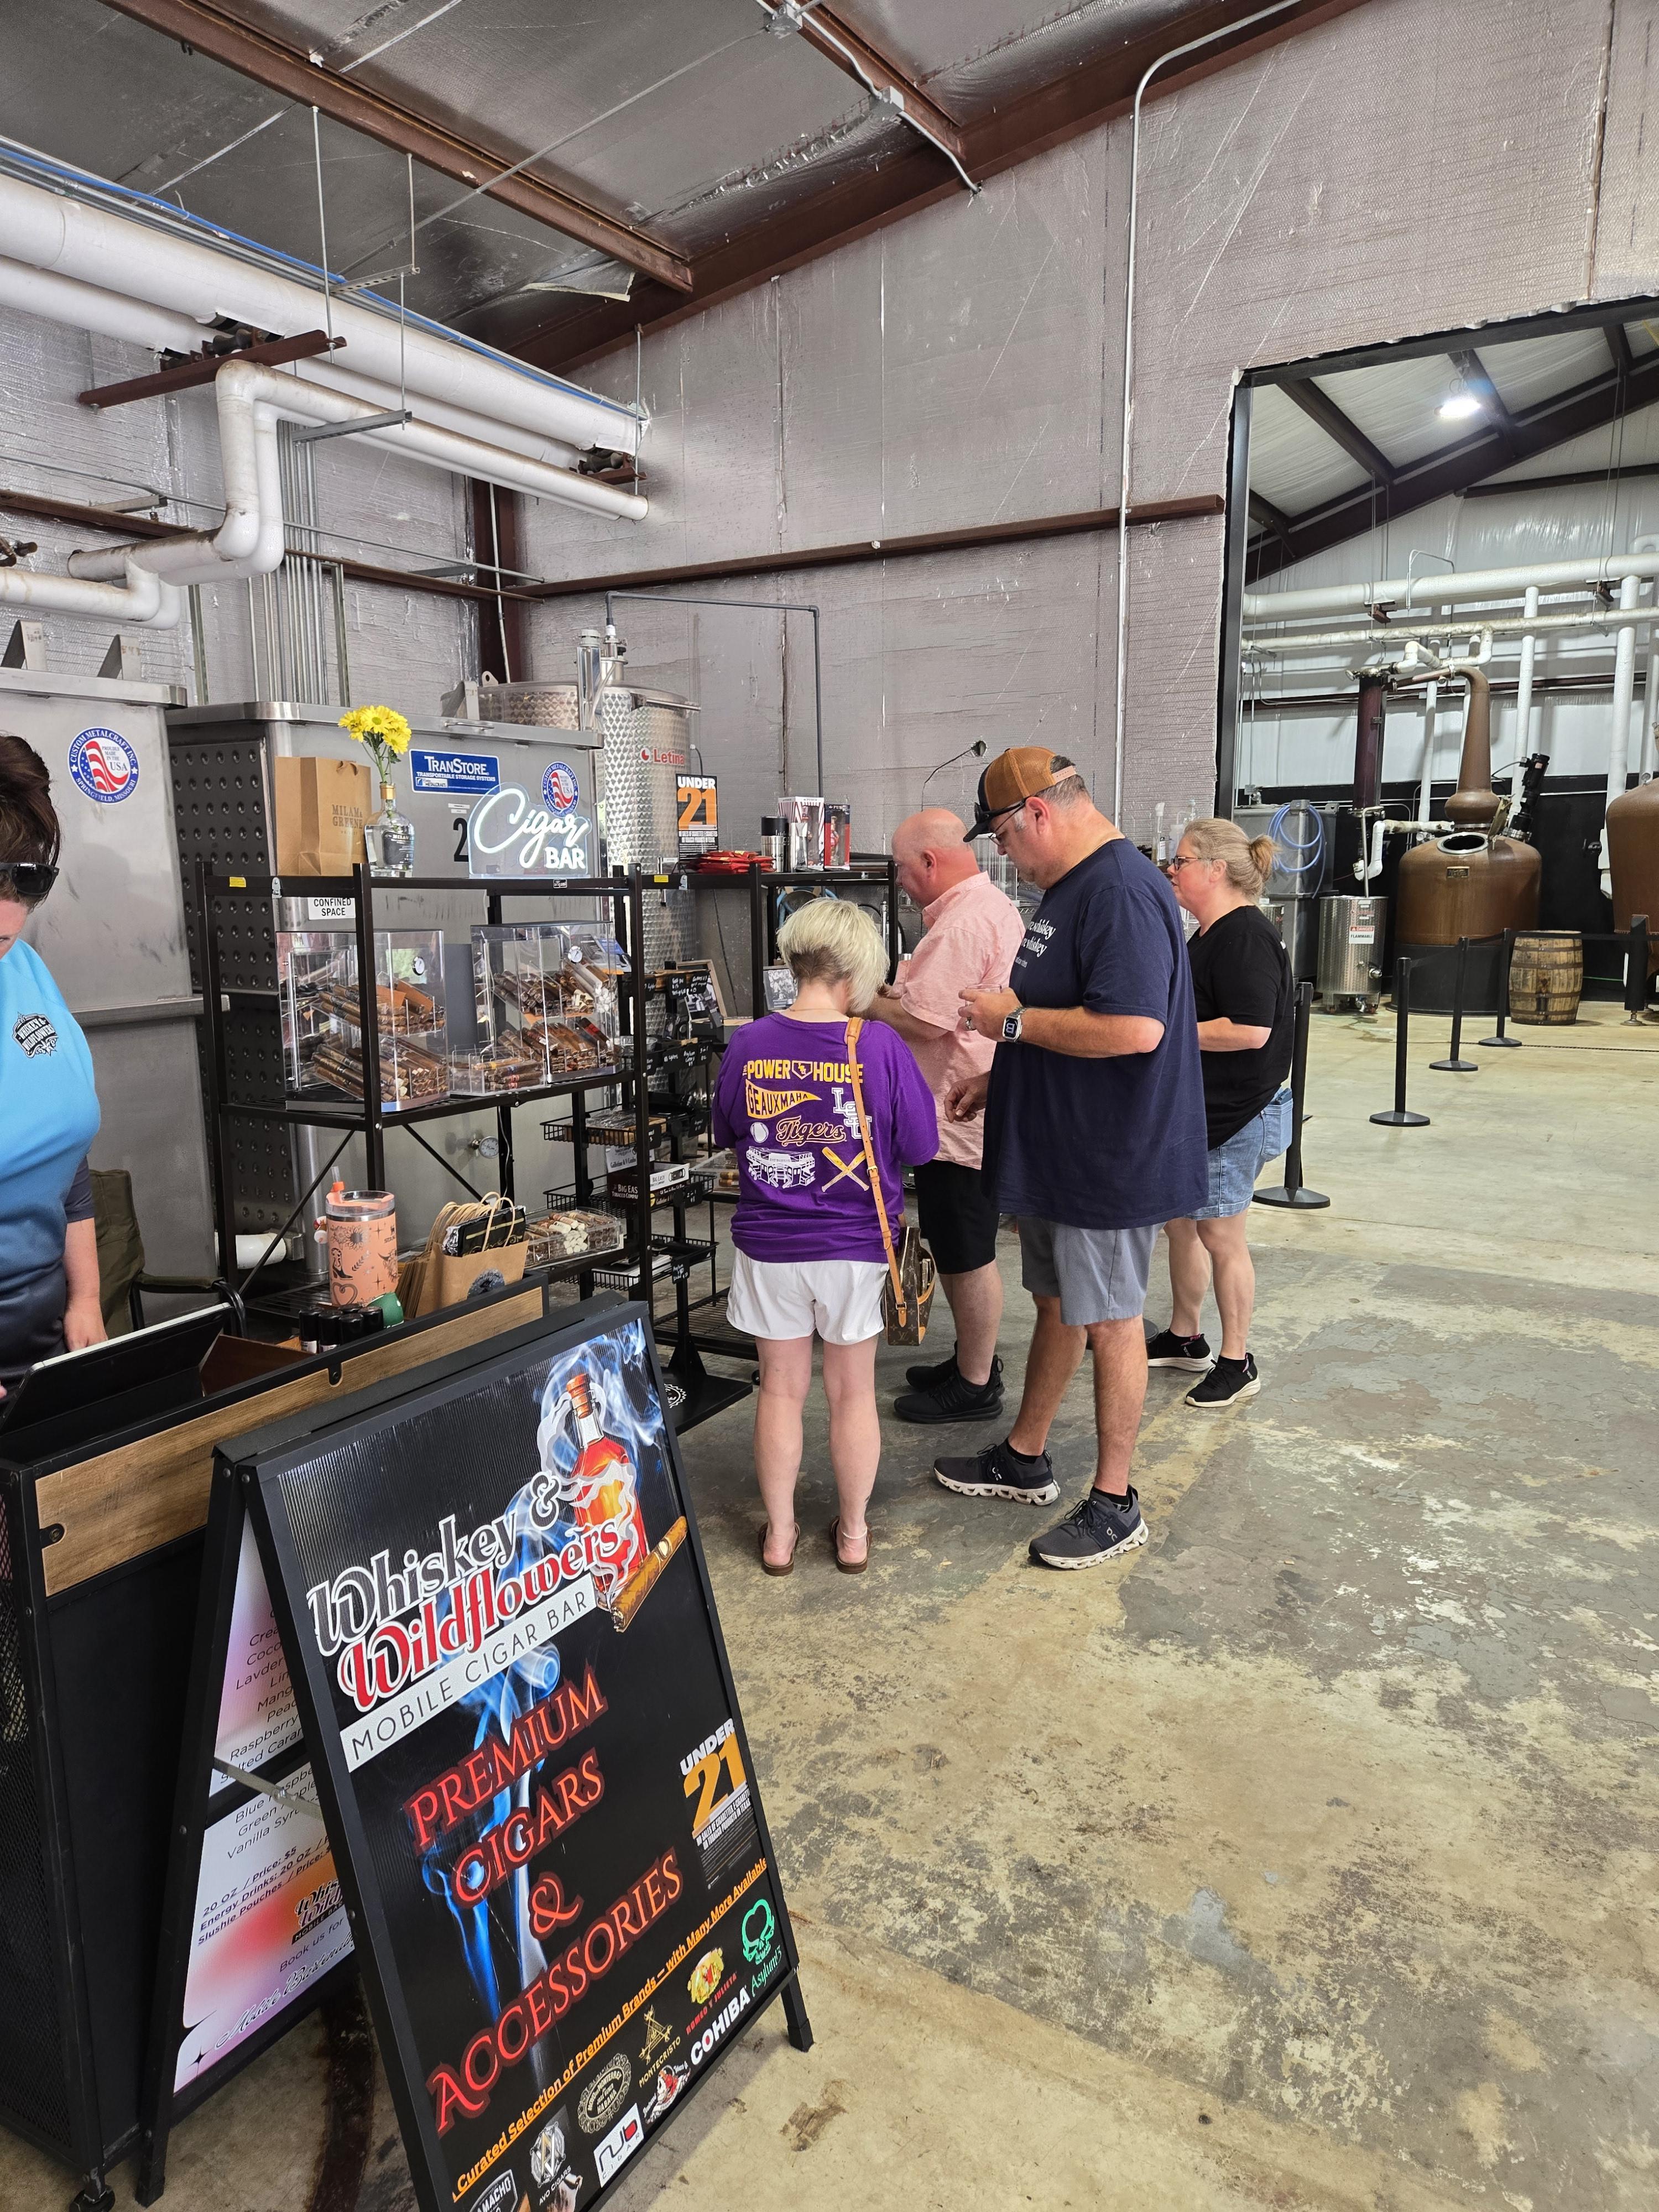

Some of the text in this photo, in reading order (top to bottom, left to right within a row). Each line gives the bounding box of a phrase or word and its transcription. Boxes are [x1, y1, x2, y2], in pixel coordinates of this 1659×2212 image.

[70, 735, 87, 762] CUSTOM
[85, 730, 129, 750] METALCRAFT
[654, 749, 685, 765] Letina
[109, 761, 127, 771] USA
[677, 776, 716, 789] UNDER
[332, 805, 359, 818] MILAM
[332, 816, 363, 830] GREENE
[677, 787, 717, 830] 21
[452, 817, 469, 862] 2
[474, 788, 589, 868] Cigar
[544, 847, 586, 870] BAR
[314, 898, 351, 907] CONFINED
[321, 907, 346, 917] SPACE
[17, 1019, 41, 1040] WHISKEY
[22, 1024, 56, 1052] WILDFLOWERS
[747, 1060, 791, 1079] POWER
[813, 1062, 863, 1083] HOUSE
[748, 1084, 808, 1116] GEAUXMAHA
[776, 1115, 847, 1147] Tigers
[618, 1183, 638, 1194] BIG EAS
[306, 1471, 562, 1657] Whiskey &
[337, 1518, 622, 1712] Wildflowers
[247, 1641, 282, 1666] Coco
[249, 1626, 279, 1646] Crea
[352, 1590, 586, 1761] MOBILE CIGAR BAR
[257, 1686, 295, 1713] Mang
[267, 1699, 298, 1723] Peac
[220, 1726, 303, 1784] Slted Cara
[230, 1713, 299, 1762] Raspberry
[680, 1718, 735, 1776] UNDER
[409, 1672, 604, 1846] PREMIUM
[683, 1731, 747, 1831] 21
[235, 1800, 264, 1824] Blue
[238, 1806, 277, 1837] Green
[456, 1754, 603, 1902] CIGARS
[227, 1827, 270, 1859] Vanilla
[200, 1900, 239, 1932] Energy
[280, 1861, 293, 1875] 20
[296, 1848, 311, 1864] OZ
[202, 1901, 218, 1918] 20
[221, 1887, 238, 1904] OZ
[284, 1845, 297, 1860] $5
[295, 1880, 340, 1917] Whis
[198, 1914, 237, 1947] Slushie
[239, 1881, 283, 1916] Pouches
[299, 1886, 343, 1928] Wild
[534, 1877, 581, 1933] &
[279, 1917, 345, 1973] Book us for
[295, 1915, 326, 1941] MOBILE
[214, 1931, 354, 2051] Mobile Bartend
[432, 1854, 681, 2131] ACCESSORIES
[713, 1973, 738, 2004] JULIETA
[457, 2132, 507, 2192] Curated
[507, 2077, 562, 2142] Selection
[562, 2059, 576, 2083] of
[575, 2013, 621, 2067] Premium
[622, 1978, 656, 2017] Brands
[665, 1943, 686, 1973] with
[686, 1917, 710, 1950] Many
[710, 1894, 733, 1924] More
[733, 1858, 767, 1901] Available
[690, 1986, 751, 2065] COHIBA
[638, 2036, 681, 2089] MONTECRISTO
[597, 2089, 617, 2115] HABANA
[477, 2176, 512, 2212] AMACHO
[539, 2165, 572, 2206] AVO CIGARS
